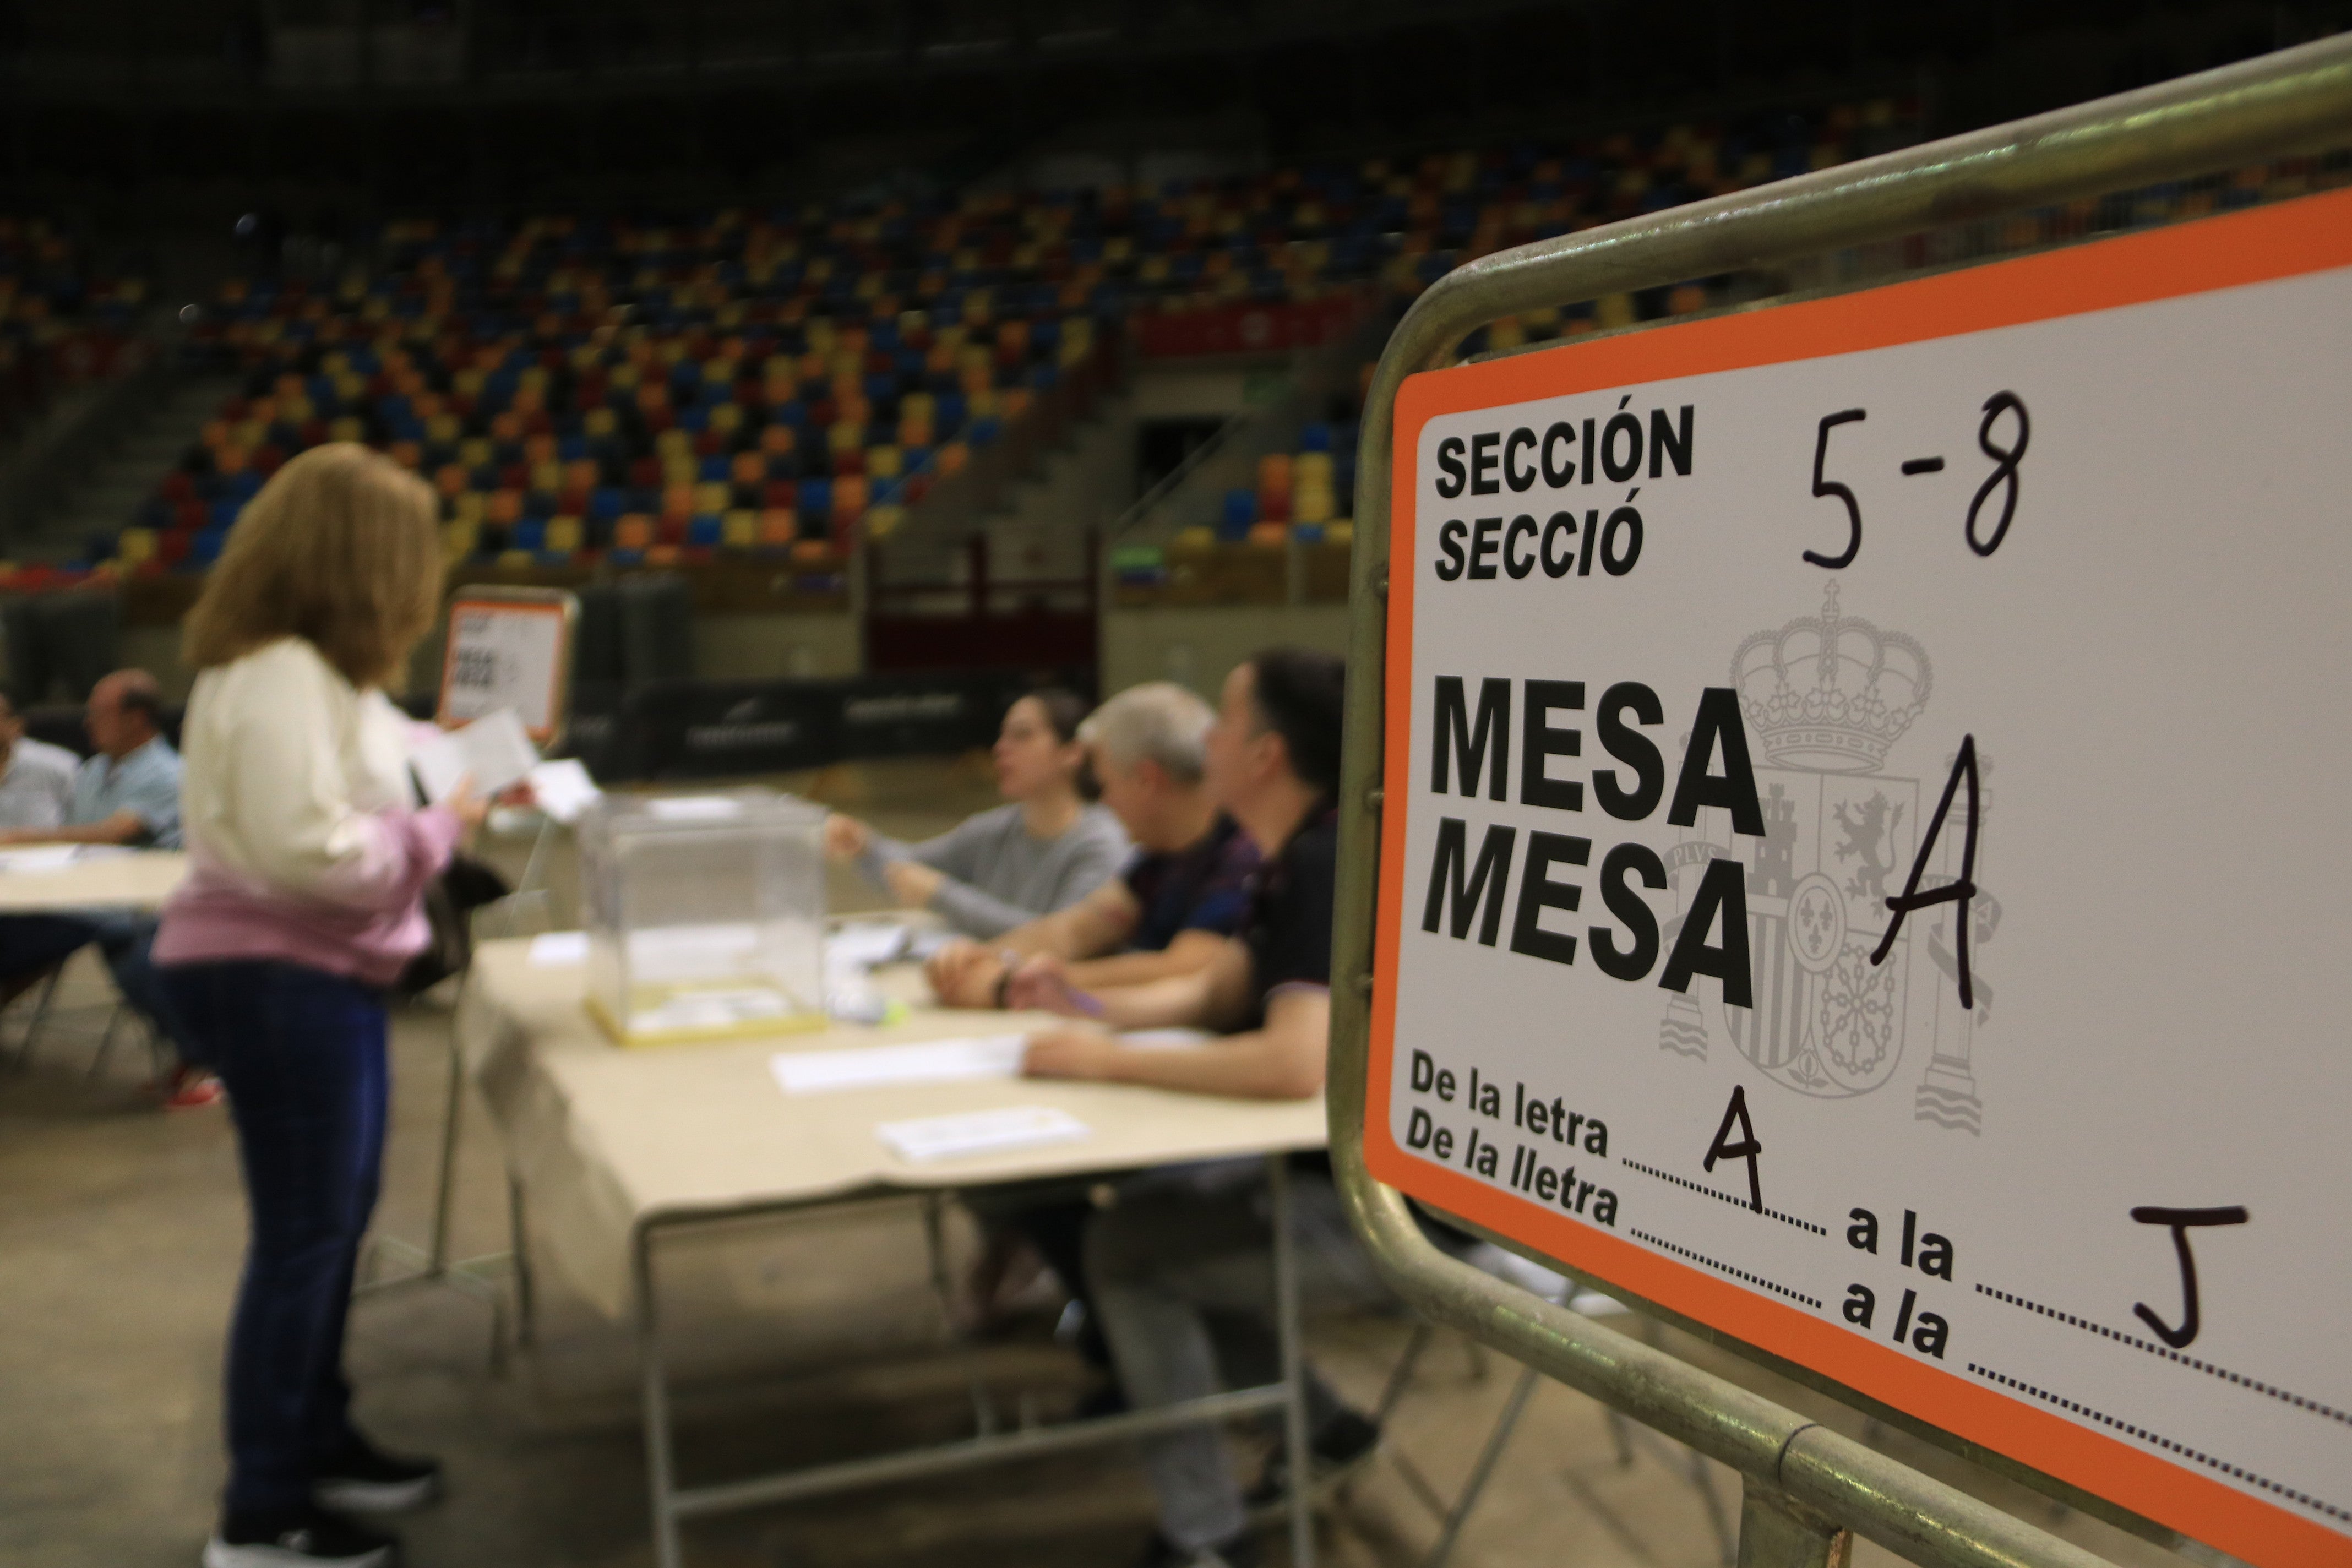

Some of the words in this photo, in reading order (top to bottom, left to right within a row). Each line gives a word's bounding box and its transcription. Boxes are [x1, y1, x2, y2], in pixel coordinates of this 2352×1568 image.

[1435, 394, 1695, 499] SECCIÓN
[1434, 487, 1644, 582] SECCIÓ
[1430, 674, 1767, 837] MESA
[1421, 817, 1753, 1009] MESA
[1869, 733, 1980, 1010] A
[1411, 1050, 1456, 1102] De
[1468, 1066, 1501, 1120] la
[1514, 1082, 1608, 1158] letra
[1702, 1084, 1763, 1215] A
[1406, 1107, 1453, 1159] De
[1465, 1128, 1499, 1179] la
[1510, 1145, 1618, 1227] lletra
[1846, 1207, 1879, 1256] a
[1901, 1208, 1954, 1282] la
[2130, 1205, 2250, 1350] J
[1842, 1283, 1876, 1330] a
[1892, 1288, 1950, 1360] la
